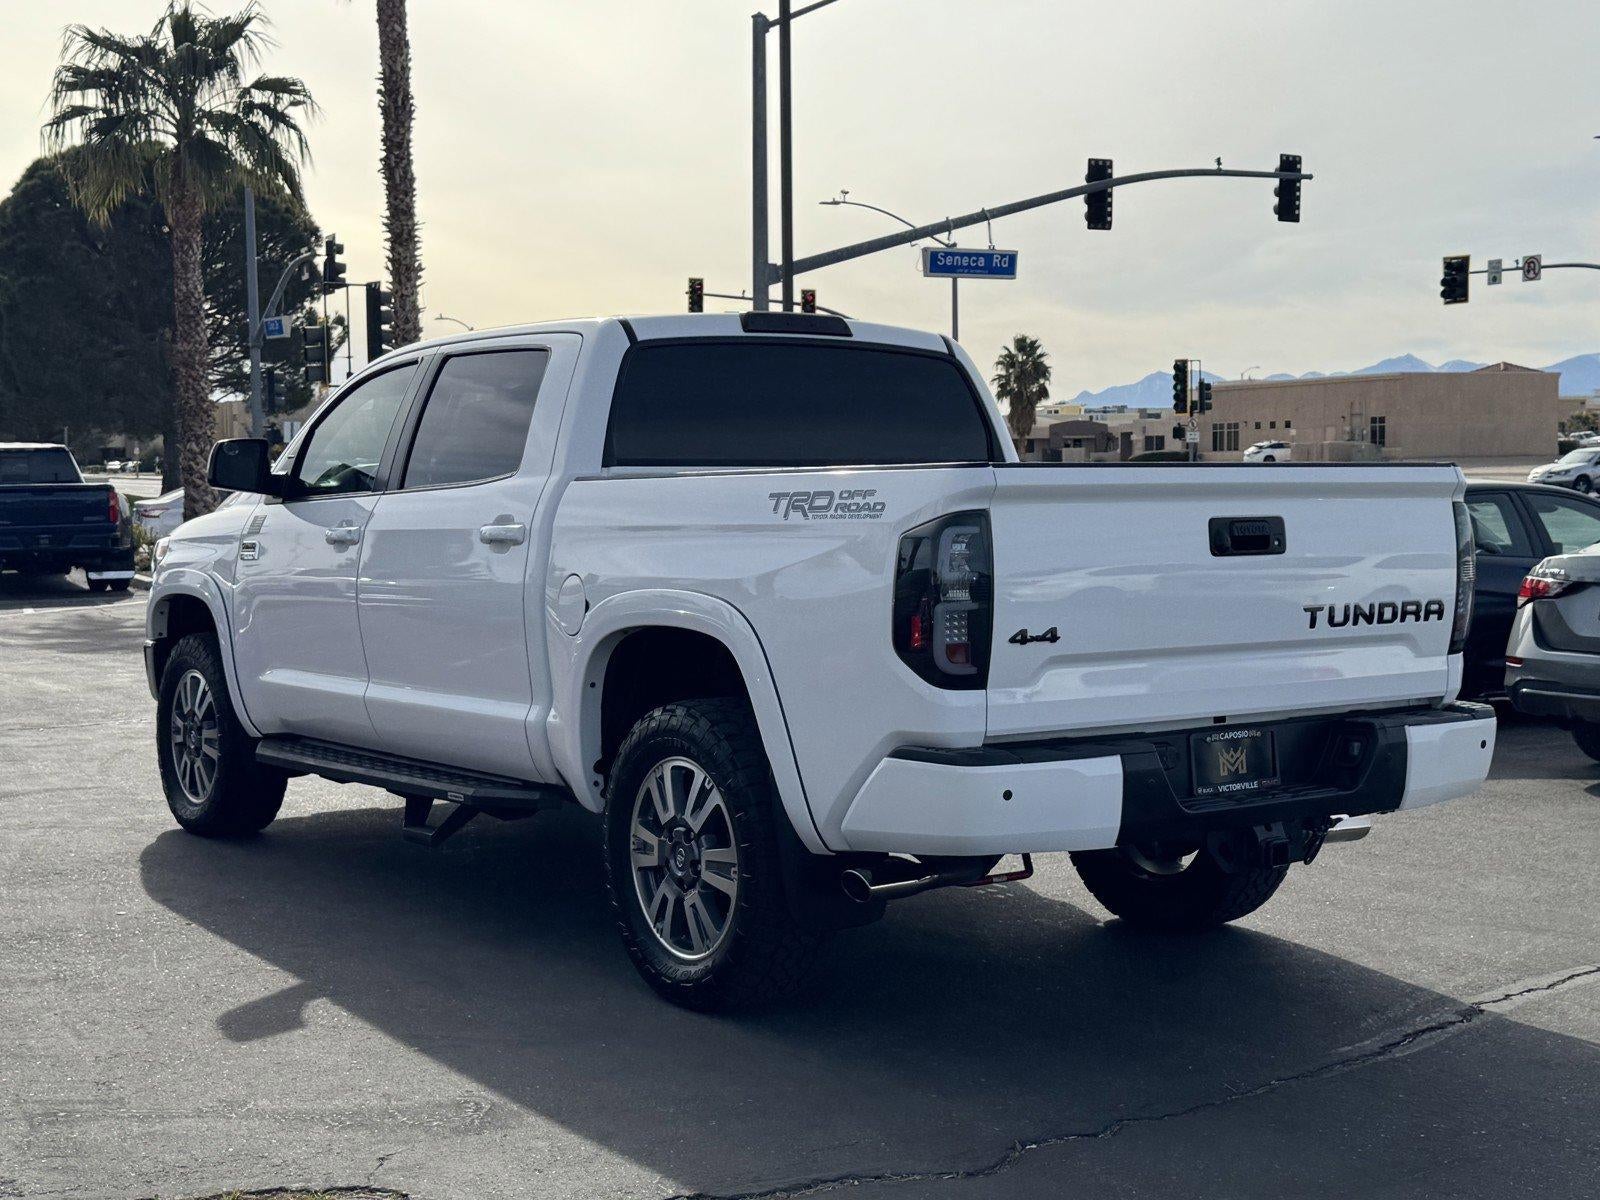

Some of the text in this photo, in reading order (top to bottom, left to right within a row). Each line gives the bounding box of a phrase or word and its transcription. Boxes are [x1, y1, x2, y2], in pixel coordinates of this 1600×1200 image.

[937, 252, 1009, 267] Seneca Rd
[838, 489, 877, 500] OFF
[768, 490, 835, 520] TRD
[834, 501, 886, 513] ROAD
[1302, 600, 1445, 629] TUNDRA
[1219, 730, 1249, 740] CAPOSIO
[1217, 780, 1259, 792] VICTORVILLE
